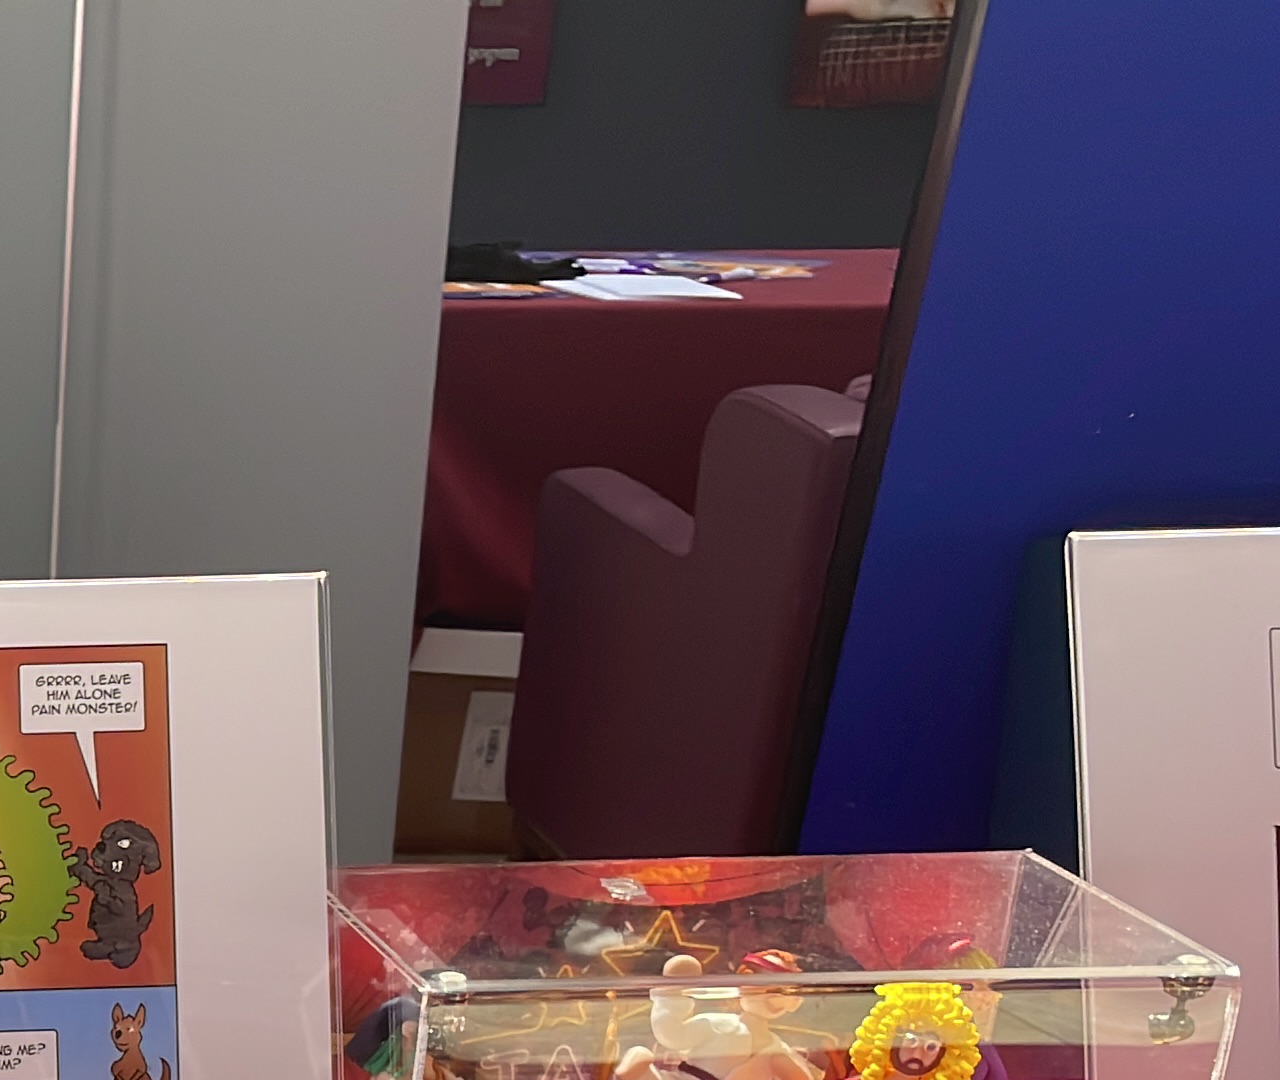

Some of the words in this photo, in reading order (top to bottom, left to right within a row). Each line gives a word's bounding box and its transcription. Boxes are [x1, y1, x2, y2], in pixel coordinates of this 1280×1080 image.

[91, 674, 131, 685] LEAVE
[47, 690, 70, 701] HIM
[74, 688, 121, 700] ALONE
[31, 704, 61, 716] PAIN
[65, 701, 138, 715] MONSTER!
[16, 1043, 46, 1056] ME?
